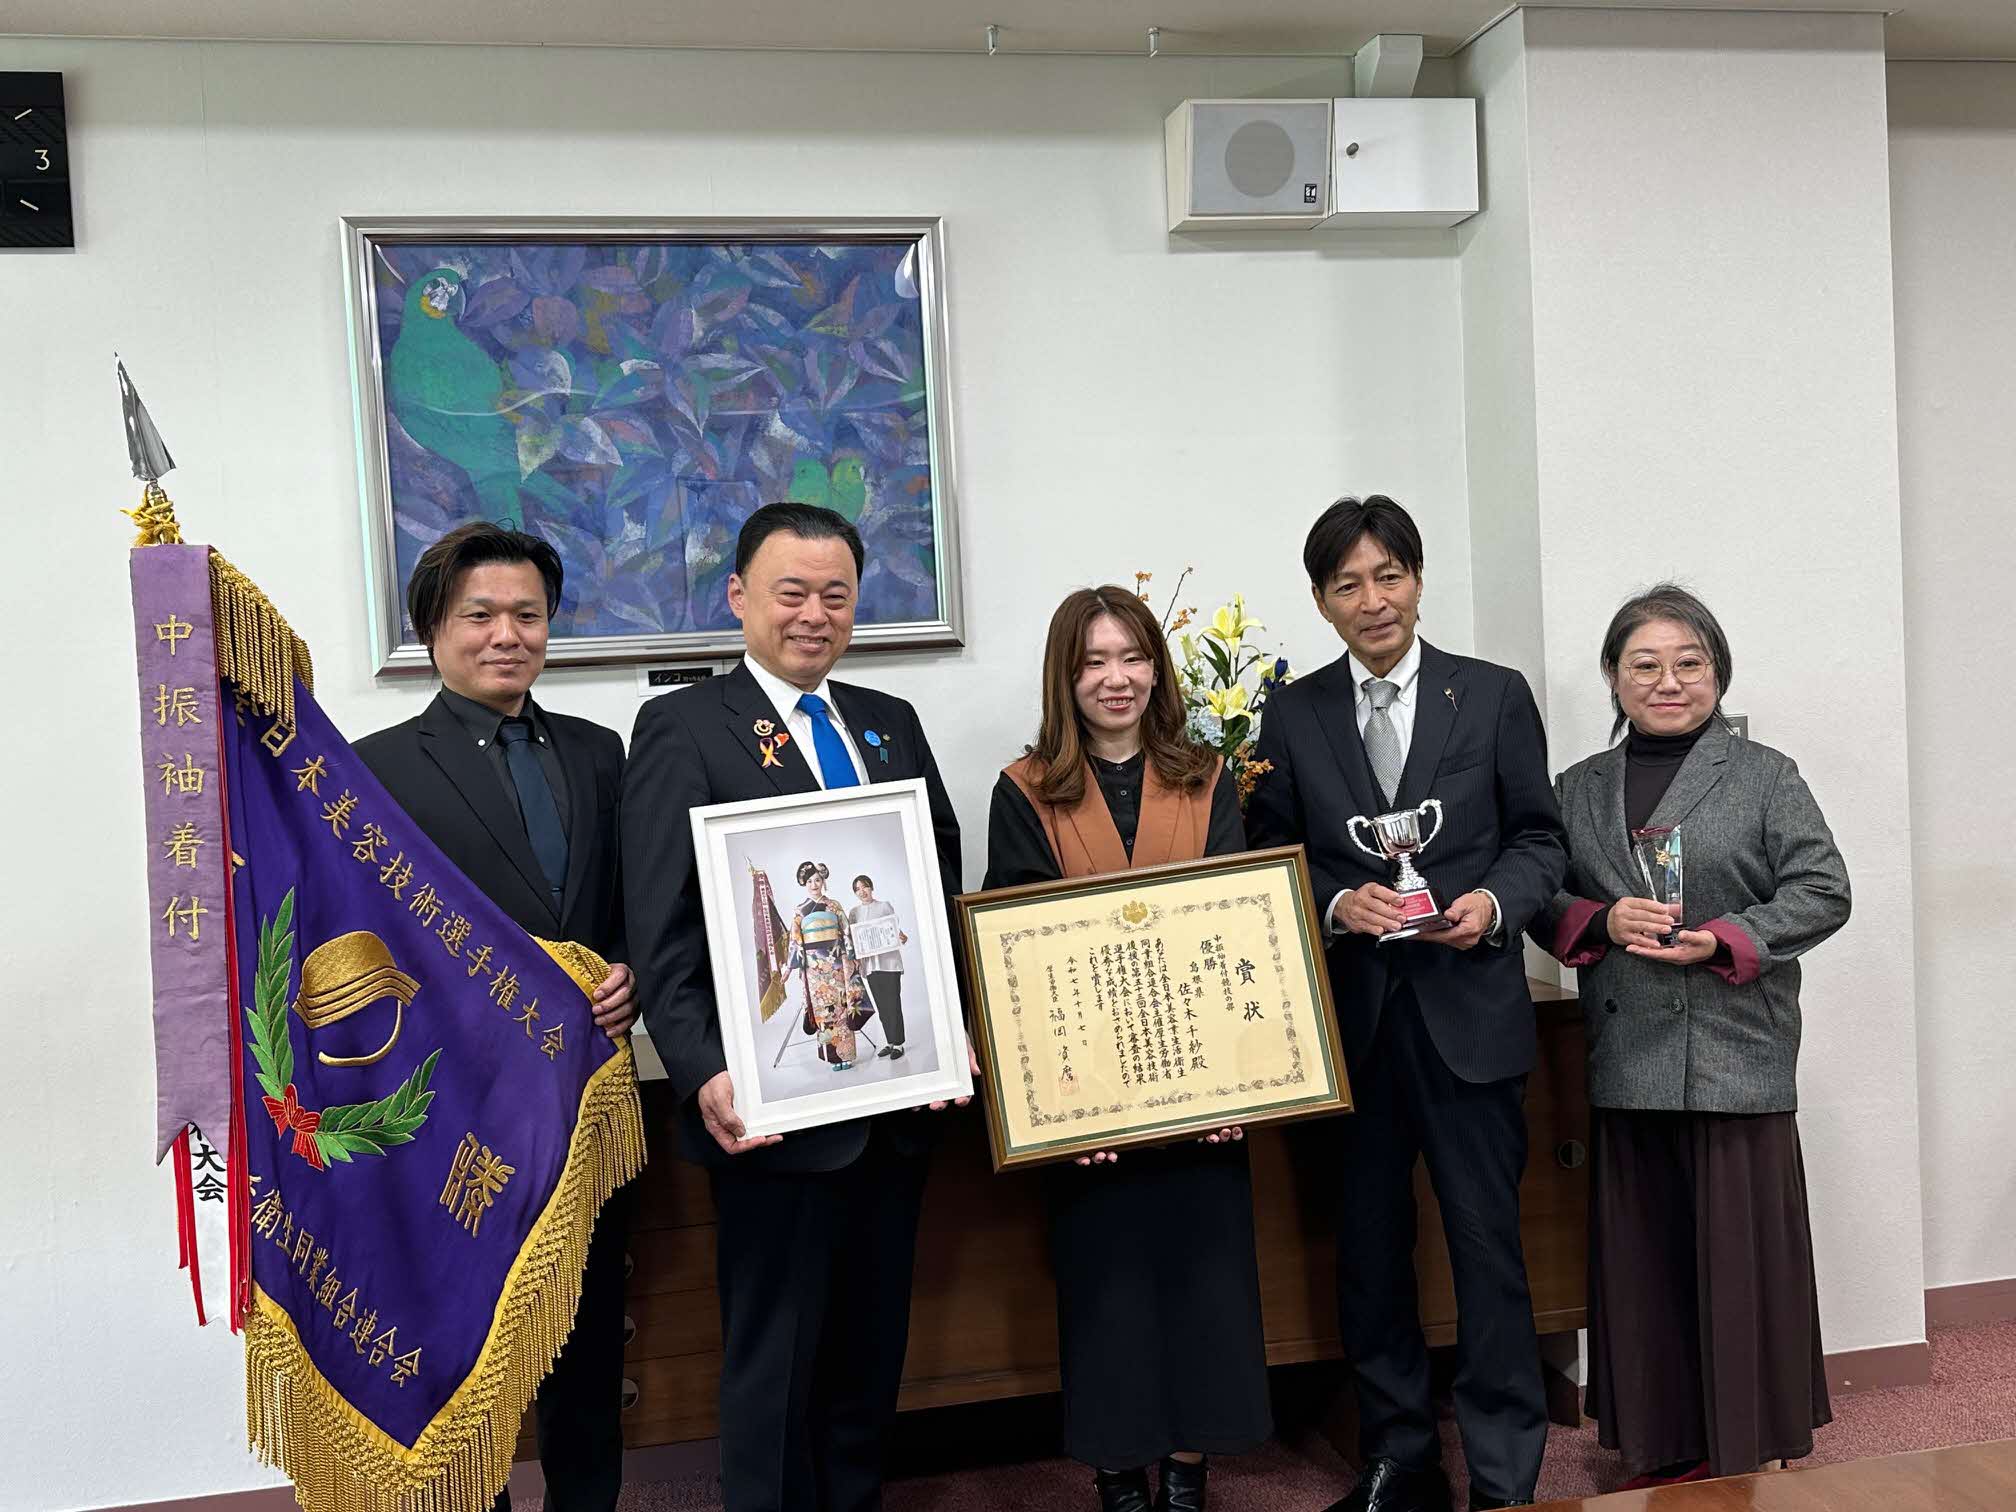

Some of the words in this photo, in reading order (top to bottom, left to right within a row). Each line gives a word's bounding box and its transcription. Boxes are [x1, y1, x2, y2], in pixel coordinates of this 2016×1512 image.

[35, 149, 50, 170] 3
[152, 614, 208, 942] 中振袖着付
[1235, 957, 1265, 1022] 賞状
[248, 1174, 424, 1388] 衛生同業組合連合会
